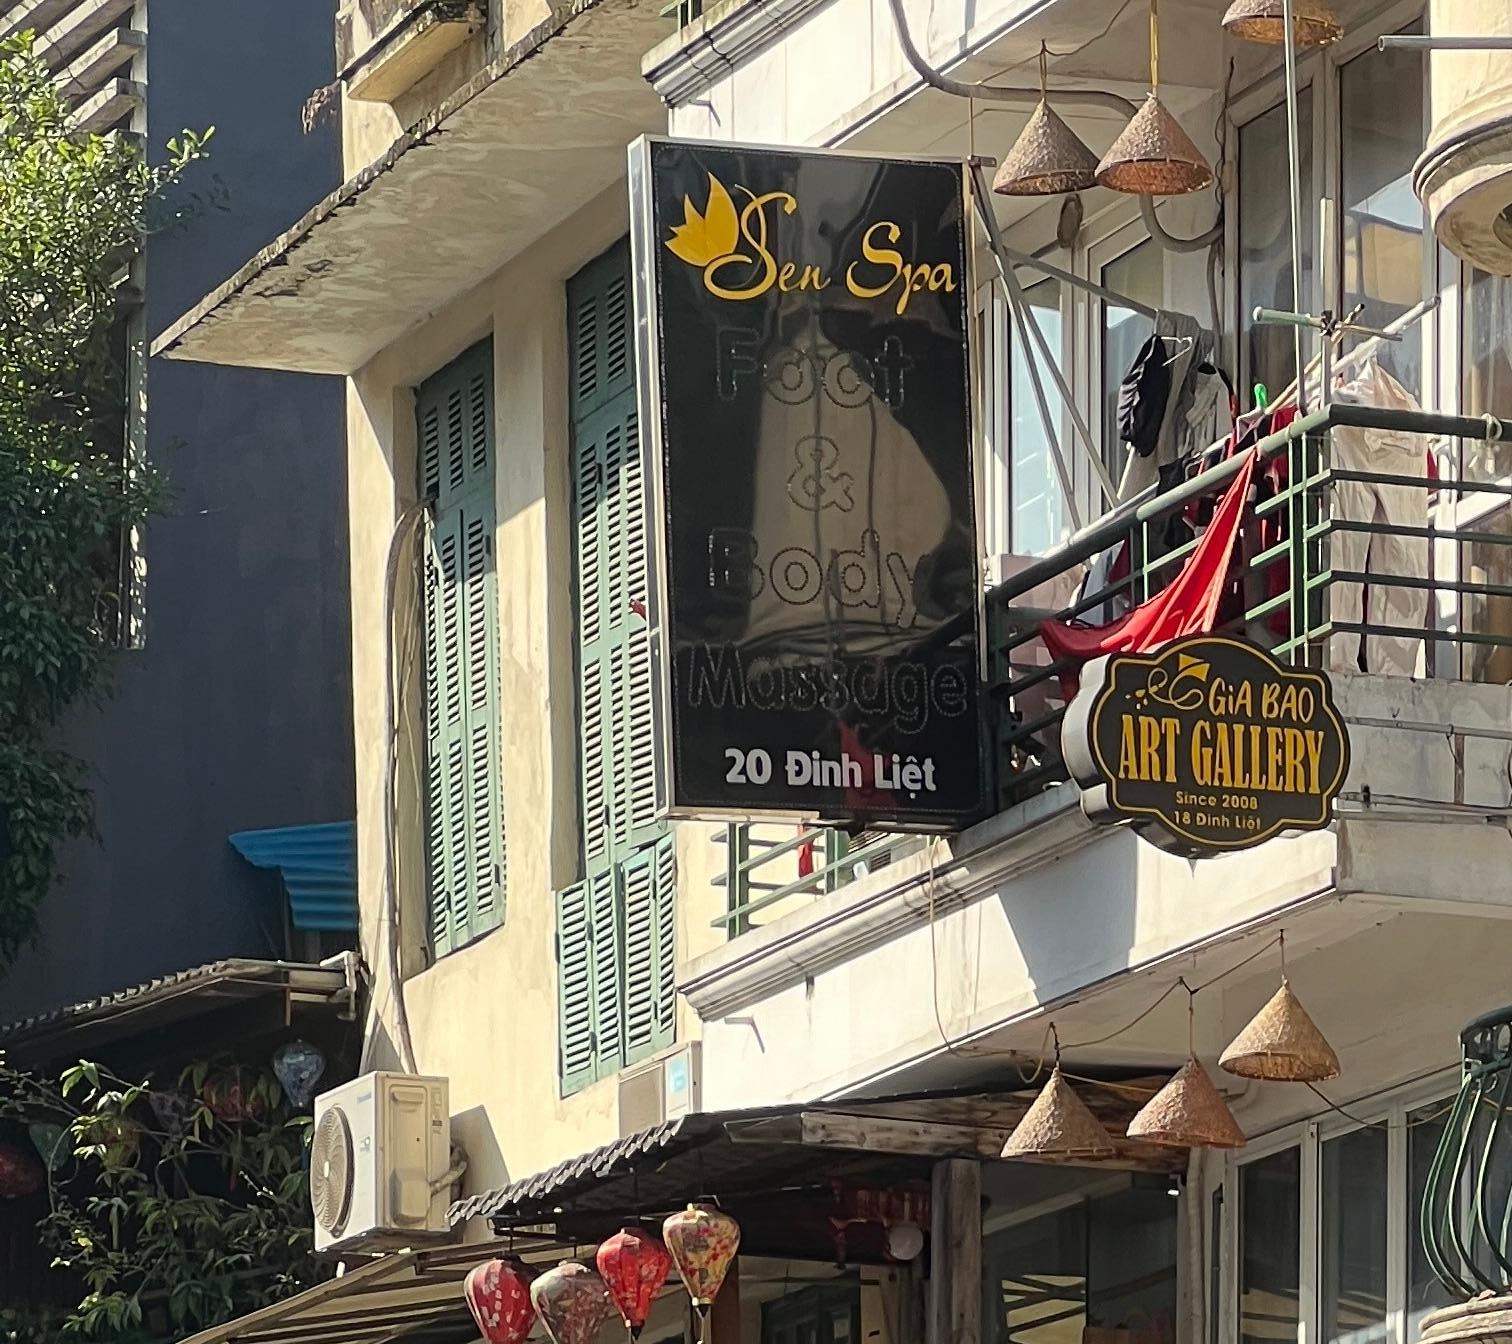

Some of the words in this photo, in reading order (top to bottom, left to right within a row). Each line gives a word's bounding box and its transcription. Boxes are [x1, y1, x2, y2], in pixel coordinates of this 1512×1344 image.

[703, 184, 831, 300] Sen
[846, 221, 958, 315] Spa
[717, 327, 916, 408] Foot
[708, 527, 932, 629] Body
[688, 640, 968, 735] Massage
[1262, 682, 1314, 723] BAO
[724, 748, 772, 784] 20
[785, 749, 862, 789] Đinh
[873, 754, 937, 799] Liệt
[1118, 714, 1181, 783] ART
[1190, 719, 1325, 794] GALLERY
[1174, 811, 1191, 824] 18
[1176, 791, 1216, 807] Since
[1222, 795, 1258, 810] 2008
